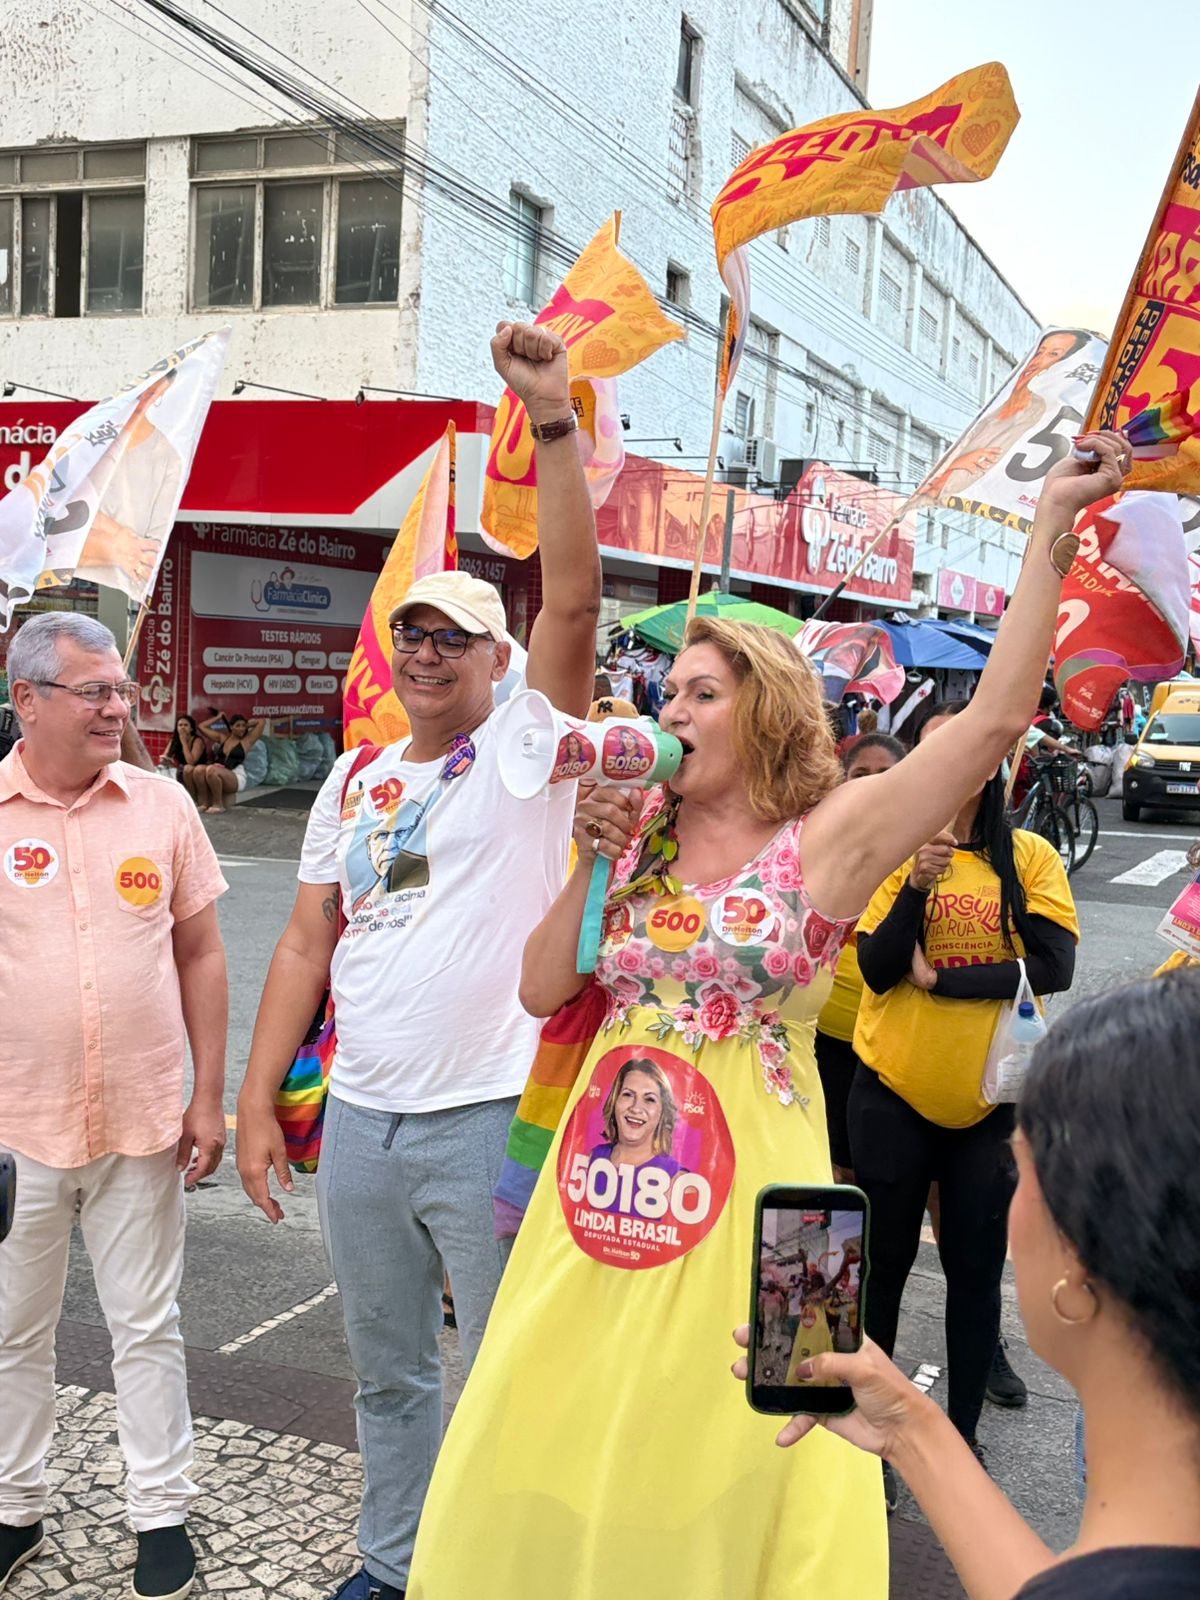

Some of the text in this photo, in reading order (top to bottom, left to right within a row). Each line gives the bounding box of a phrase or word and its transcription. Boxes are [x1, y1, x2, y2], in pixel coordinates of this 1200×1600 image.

[212, 522, 356, 561] Farmácia Zé do Bairro
[156, 558, 173, 675] Zé do Bairro
[260, 629, 322, 644] TESTES RÁPIDOS
[268, 680, 280, 690] HIV
[553, 760, 591, 777] 50180
[605, 755, 650, 772] 50180
[369, 777, 404, 810] 50
[14, 846, 51, 871] 50
[119, 872, 160, 890] 500
[651, 909, 701, 934] 500
[722, 896, 766, 924] 50
[947, 919, 976, 937] RUA
[929, 941, 993, 952] CONSCIÊNCIA
[567, 1153, 712, 1226] 50180
[573, 1207, 682, 1247] LINDA BRASIL
[583, 1231, 661, 1252] DEPUTADA ESTADUAL
